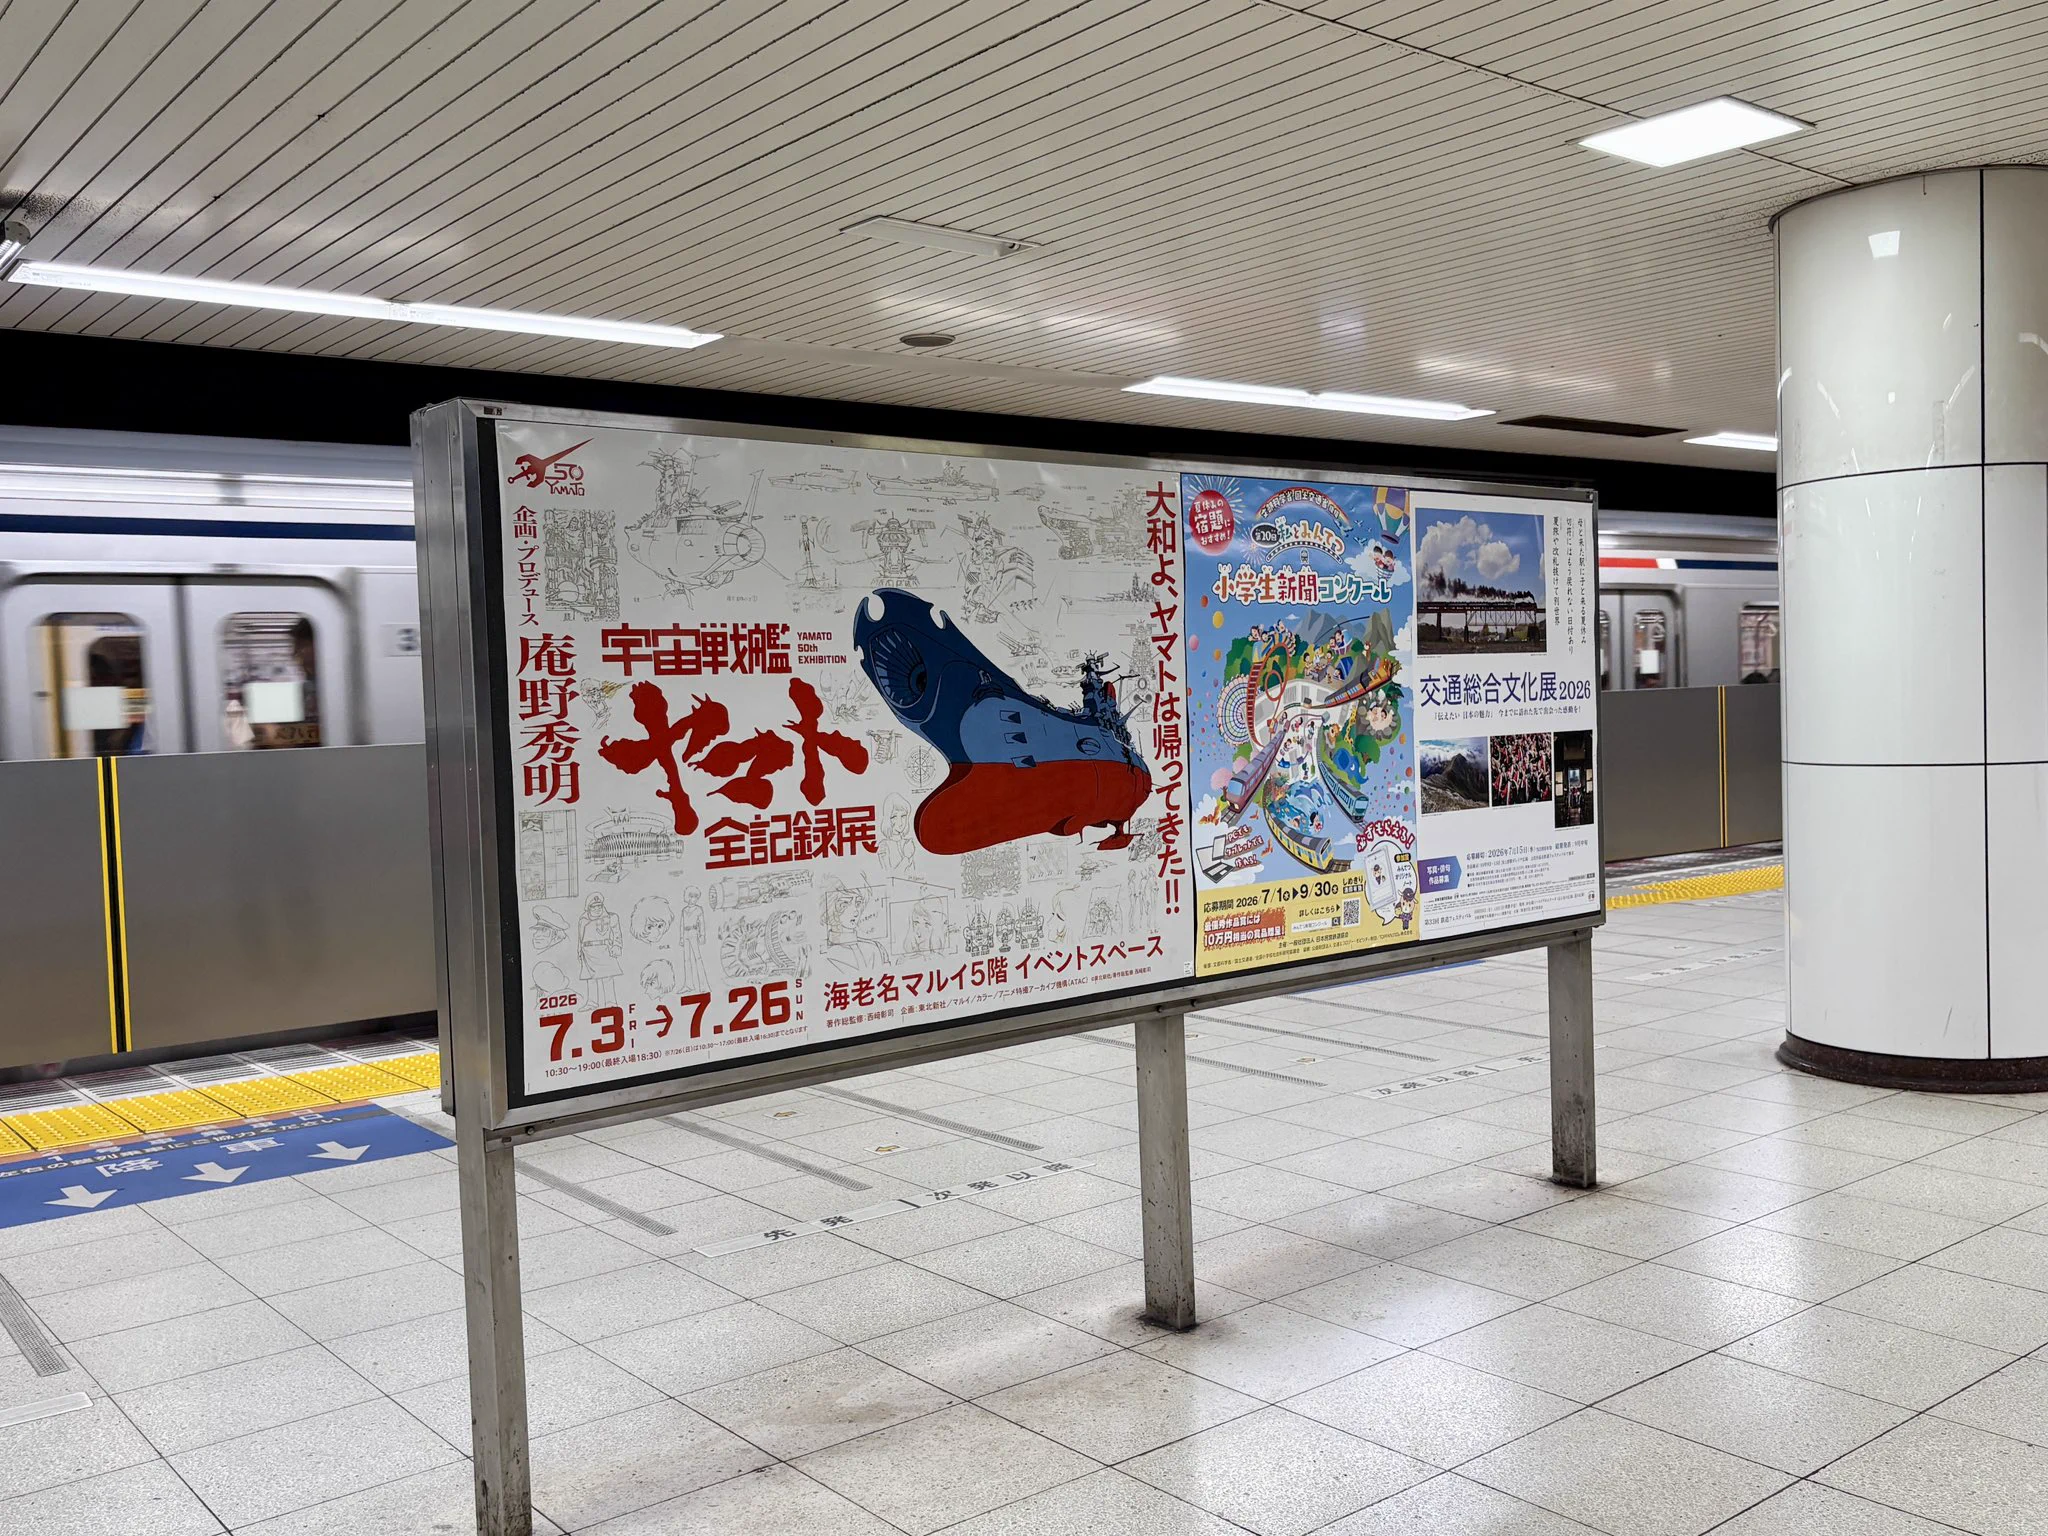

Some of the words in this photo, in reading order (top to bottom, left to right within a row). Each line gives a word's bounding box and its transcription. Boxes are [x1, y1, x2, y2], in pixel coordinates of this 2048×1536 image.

[1194, 499, 1224, 513] 夏休みの
[1194, 510, 1231, 534] 宿題に
[512, 505, 540, 627] 企画・プロデュース
[1213, 569, 1391, 605] 小学生新聞コンクール
[601, 623, 792, 676] 宇宙戦艦
[797, 630, 832, 642] YAMATO
[797, 643, 819, 653] 50th
[798, 654, 847, 665] EXHIBITION
[1419, 671, 1591, 707] 交通総合文化展2026
[516, 633, 582, 807] 庵野秀明
[598, 676, 870, 836] ヤマト
[704, 805, 879, 870] 全記録展
[1204, 899, 1233, 913] 応募期間
[1299, 905, 1336, 918] 詳しくはこちら
[824, 957, 1008, 1012] 海老名マルイ5階
[1015, 935, 1164, 978] イベントスペース
[539, 994, 577, 1010] 2026
[539, 1006, 624, 1062] 7.3
[629, 1004, 637, 1049] FRI
[681, 980, 791, 1038] 7.26
[795, 979, 803, 1021] SUN
[95, 1137, 286, 1178] 降車
[763, 1214, 854, 1242] 先発
[926, 1160, 1076, 1203] 次発以降
